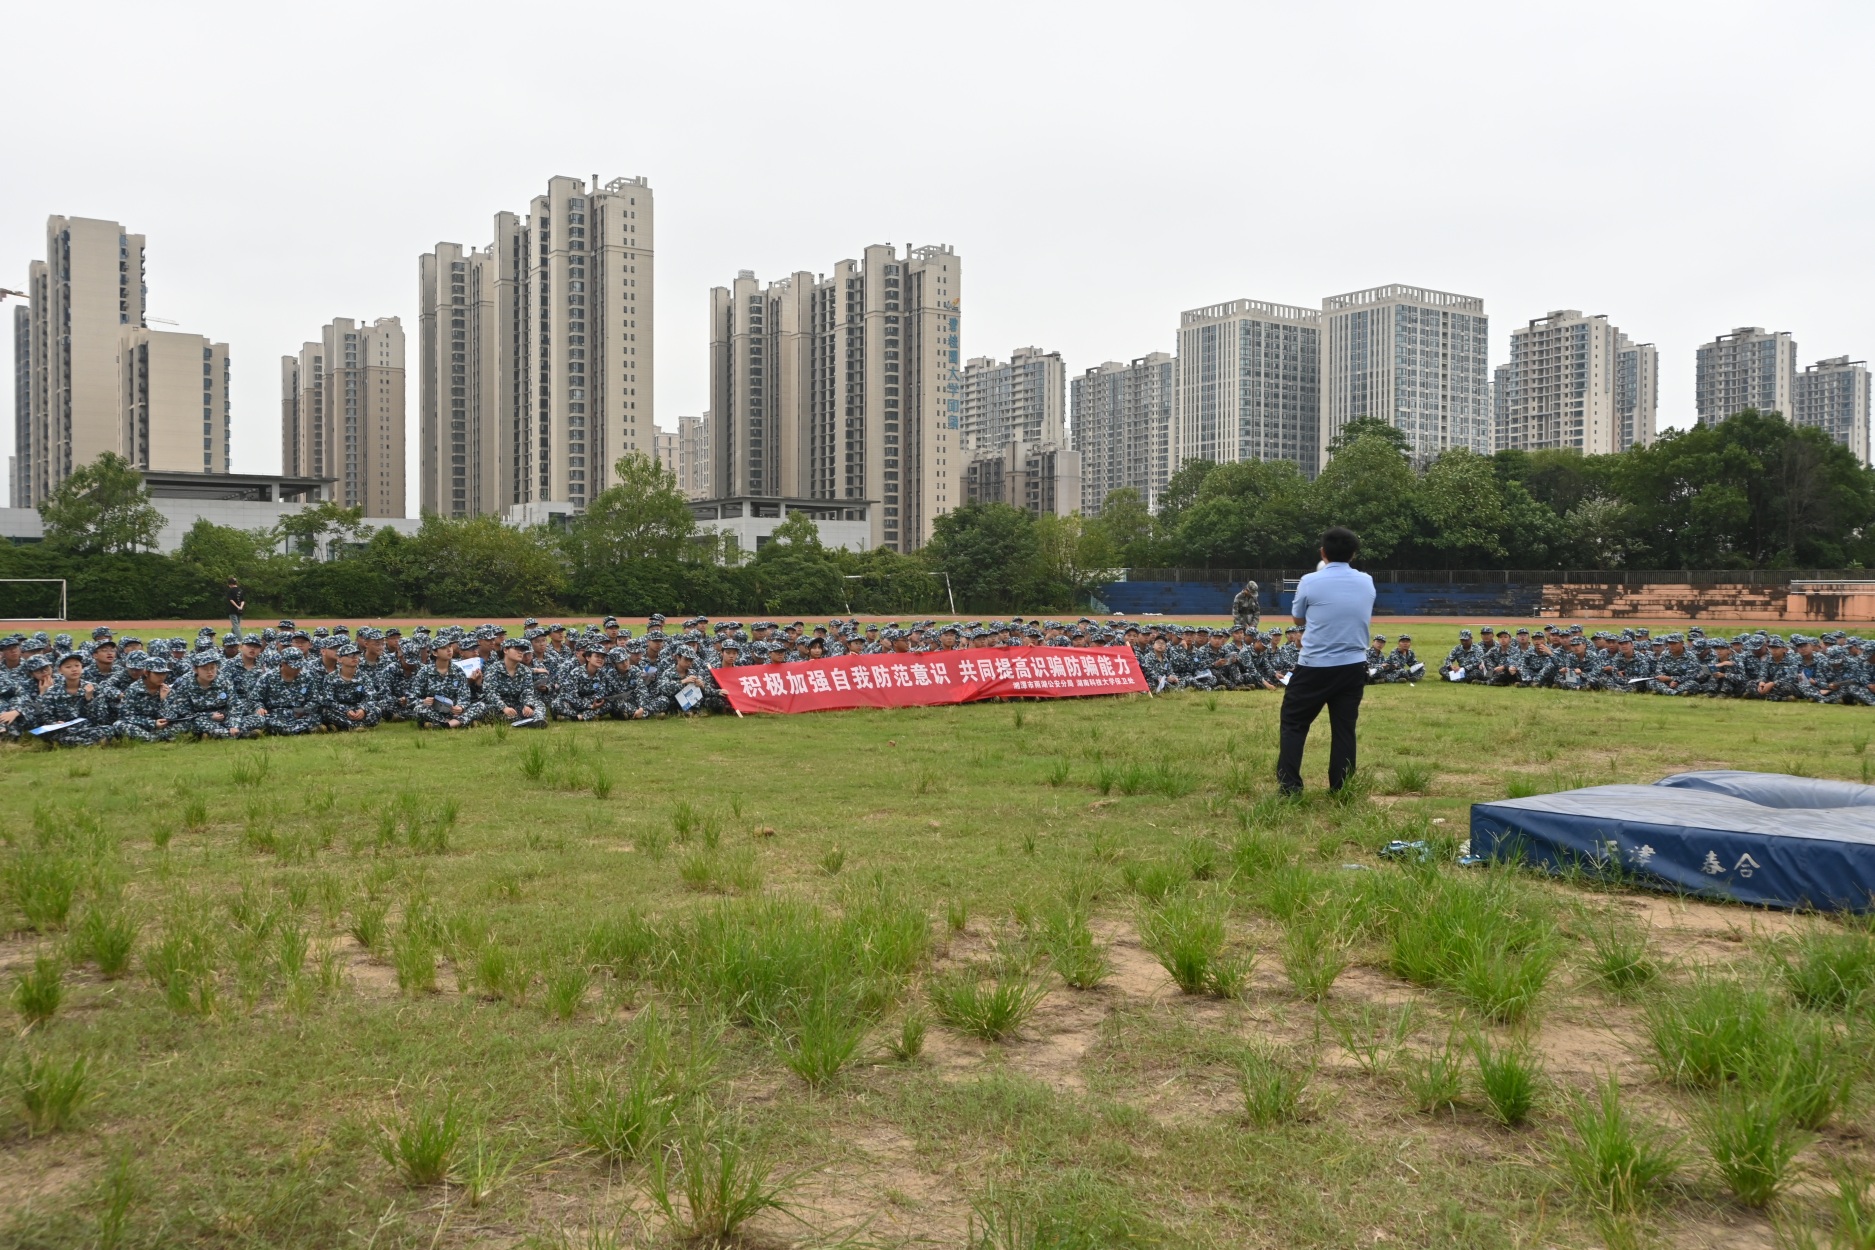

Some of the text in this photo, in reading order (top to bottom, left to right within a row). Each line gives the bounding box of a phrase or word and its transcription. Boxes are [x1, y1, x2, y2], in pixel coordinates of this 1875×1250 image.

[738, 654, 1131, 698] 积极加强自我防范意识 共同提高识骗防骗能力
[1701, 850, 1761, 878] 春合
